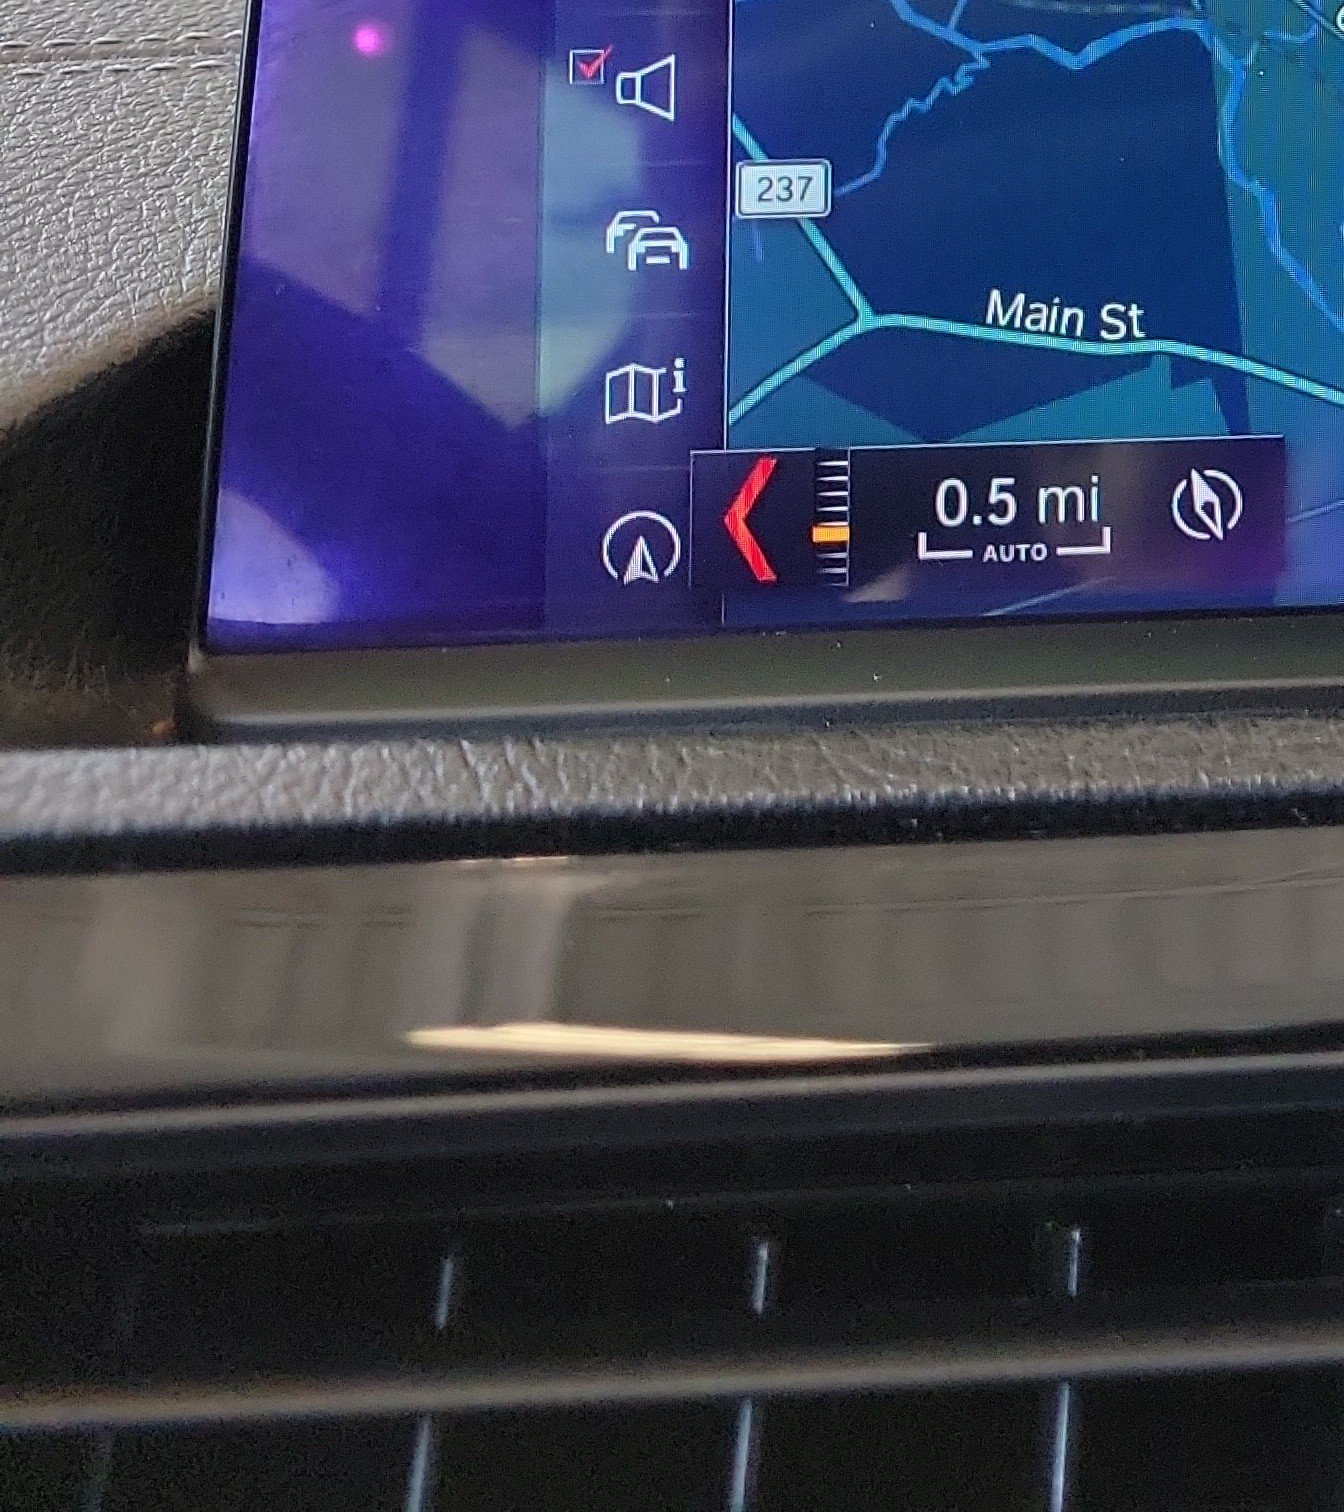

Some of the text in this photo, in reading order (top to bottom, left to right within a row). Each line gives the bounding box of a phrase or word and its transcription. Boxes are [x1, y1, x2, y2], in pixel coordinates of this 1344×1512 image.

[756, 175, 815, 204] 237
[985, 289, 1146, 340] Main St
[934, 474, 1100, 527] 0.5 mi
[982, 541, 1048, 563] AUTO
